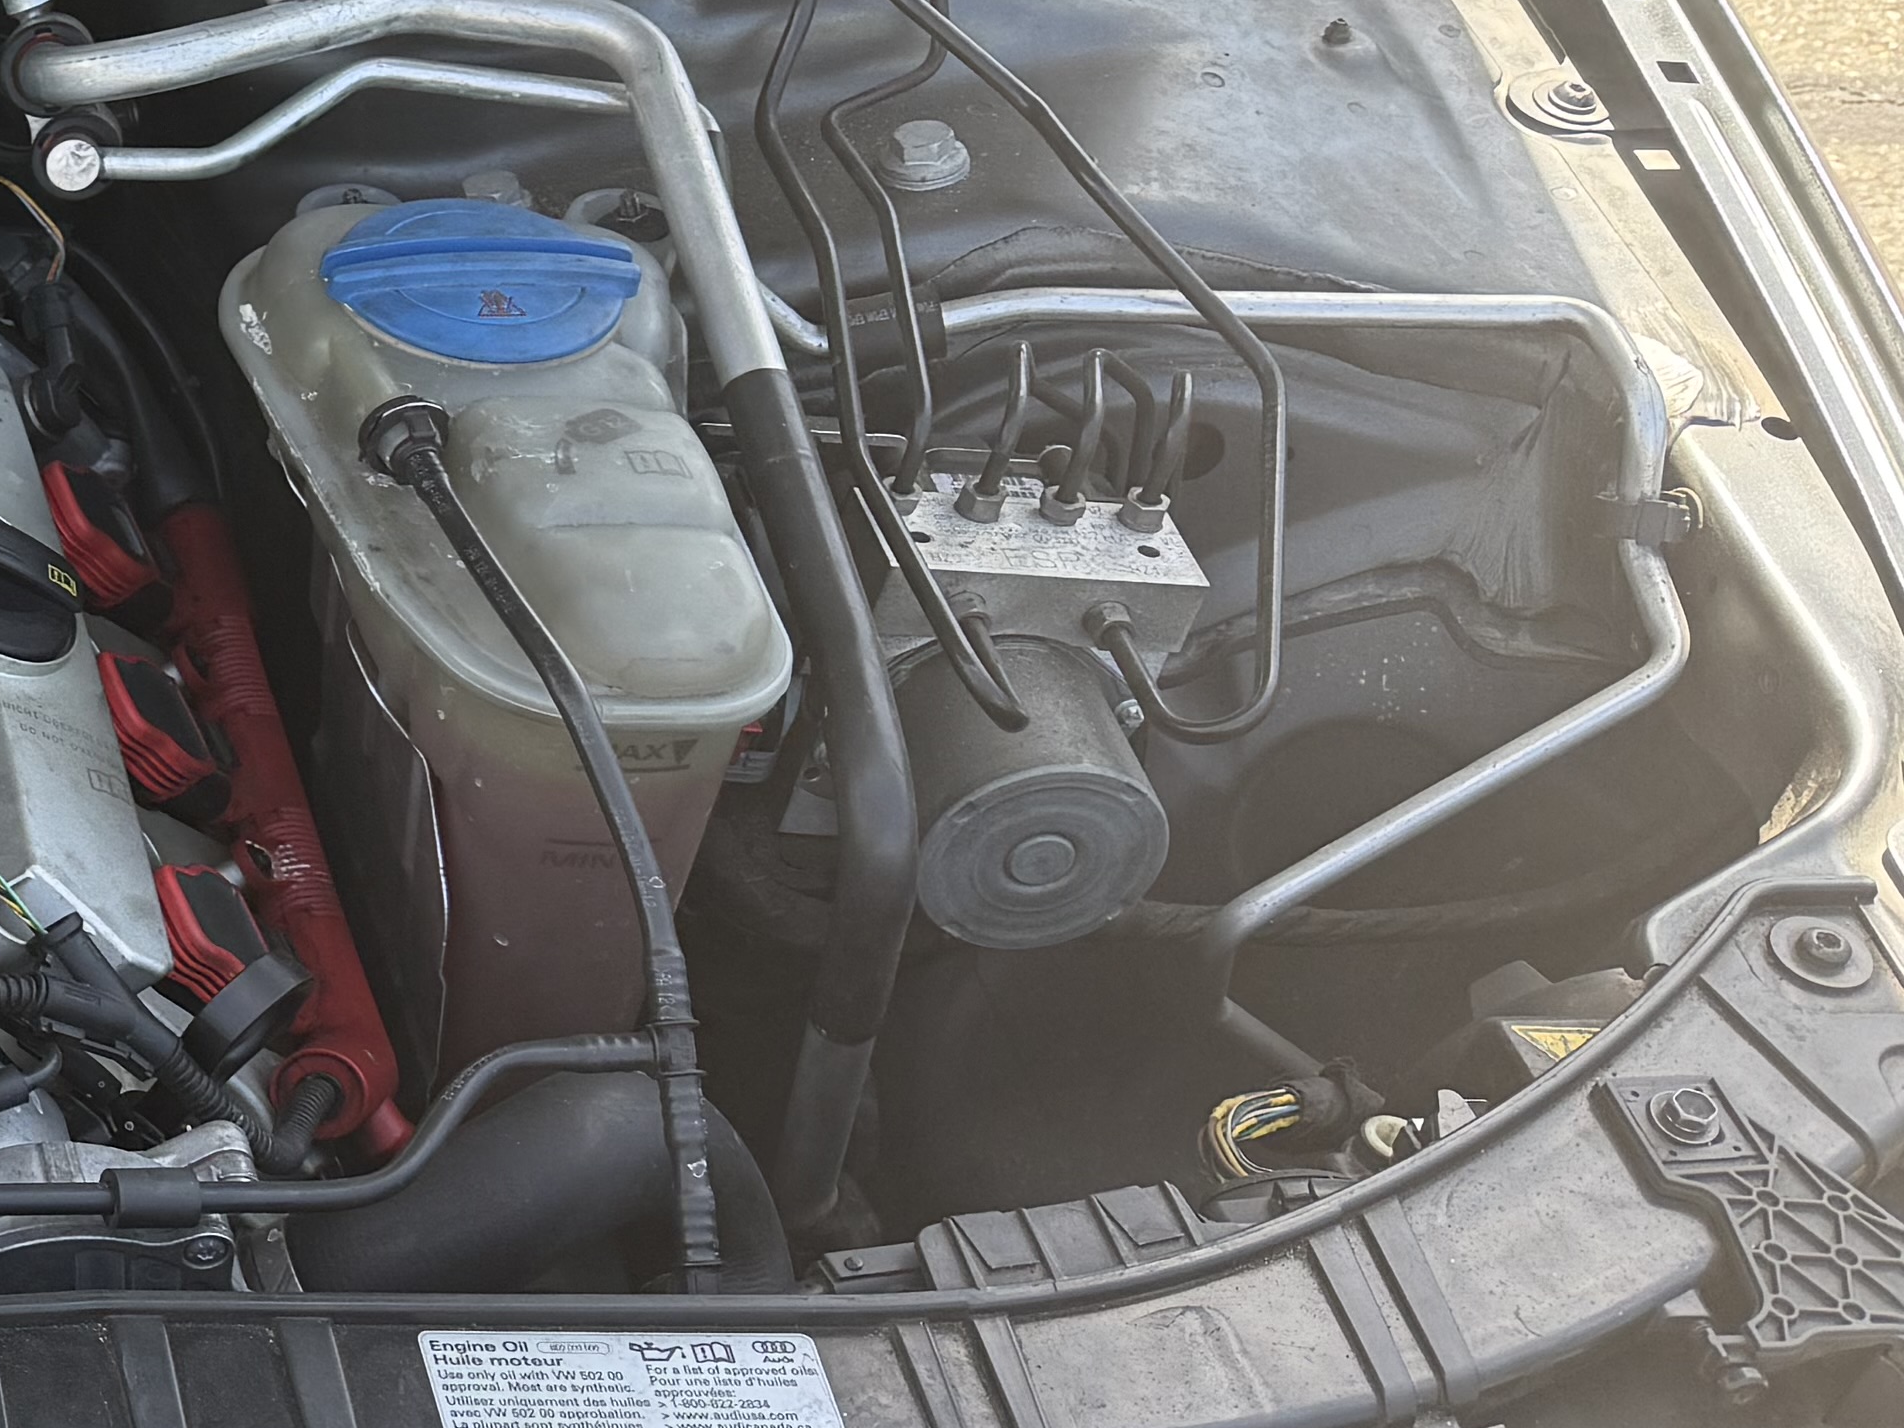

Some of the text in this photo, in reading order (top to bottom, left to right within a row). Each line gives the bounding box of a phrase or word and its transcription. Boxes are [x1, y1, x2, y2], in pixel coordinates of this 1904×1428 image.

[429, 1340, 529, 1355] Engine Oil
[433, 1354, 564, 1367] Huile moteur
[763, 1355, 794, 1363] Audi
[437, 1370, 624, 1383] Use only oil with VW 502 00
[645, 1364, 668, 1374] For
[683, 1364, 703, 1375] list
[707, 1364, 720, 1375] of
[725, 1365, 786, 1378] approved
[649, 1376, 798, 1387] Pour une liste d'huiles
[442, 1382, 636, 1395] approval. Most are synthetic.
[654, 1388, 737, 1400] approuvées:
[445, 1395, 651, 1409] Utilisez uniquement des huiles
[450, 1408, 645, 1421] avec VW 502 00 approbation.
[673, 1410, 799, 1421] www.audiusa.com
